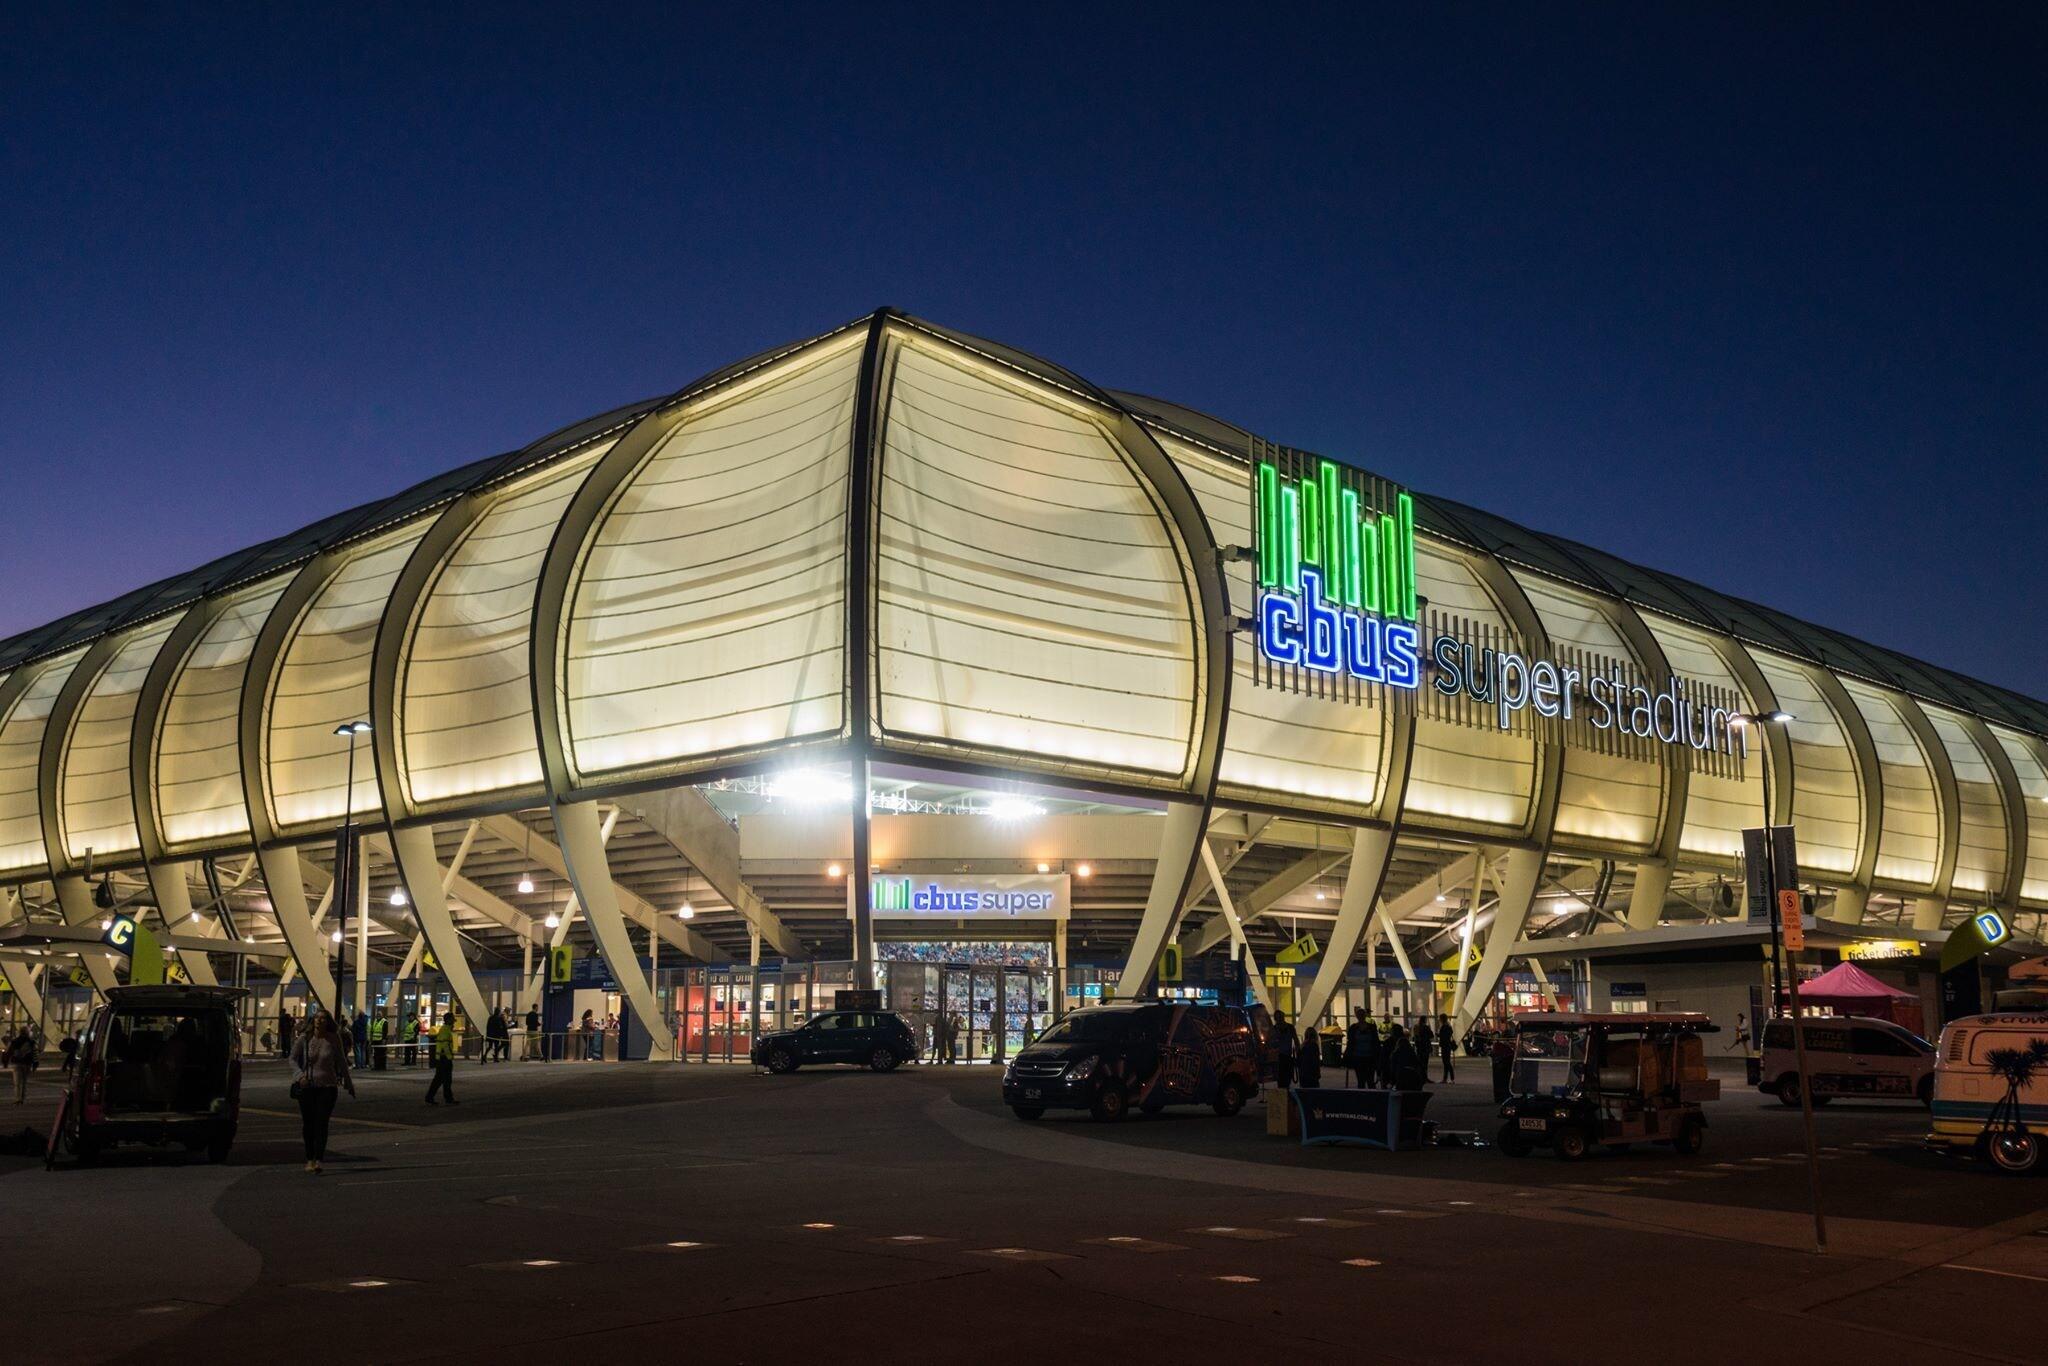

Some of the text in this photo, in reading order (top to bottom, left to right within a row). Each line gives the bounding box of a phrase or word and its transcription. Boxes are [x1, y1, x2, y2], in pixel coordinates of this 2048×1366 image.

[1259, 563, 1420, 689] cbus
[1432, 635, 1747, 759] super stadium
[914, 885, 1052, 915] cbus super
[110, 919, 134, 945] C
[1976, 914, 2003, 941] D
[1298, 939, 1310, 956] 17
[175, 966, 186, 980] 13
[555, 950, 565, 978] C
[1166, 948, 1177, 977] D
[76, 972, 89, 984] 12
[1280, 970, 1290, 985] 17
[1514, 979, 1529, 992] Food
